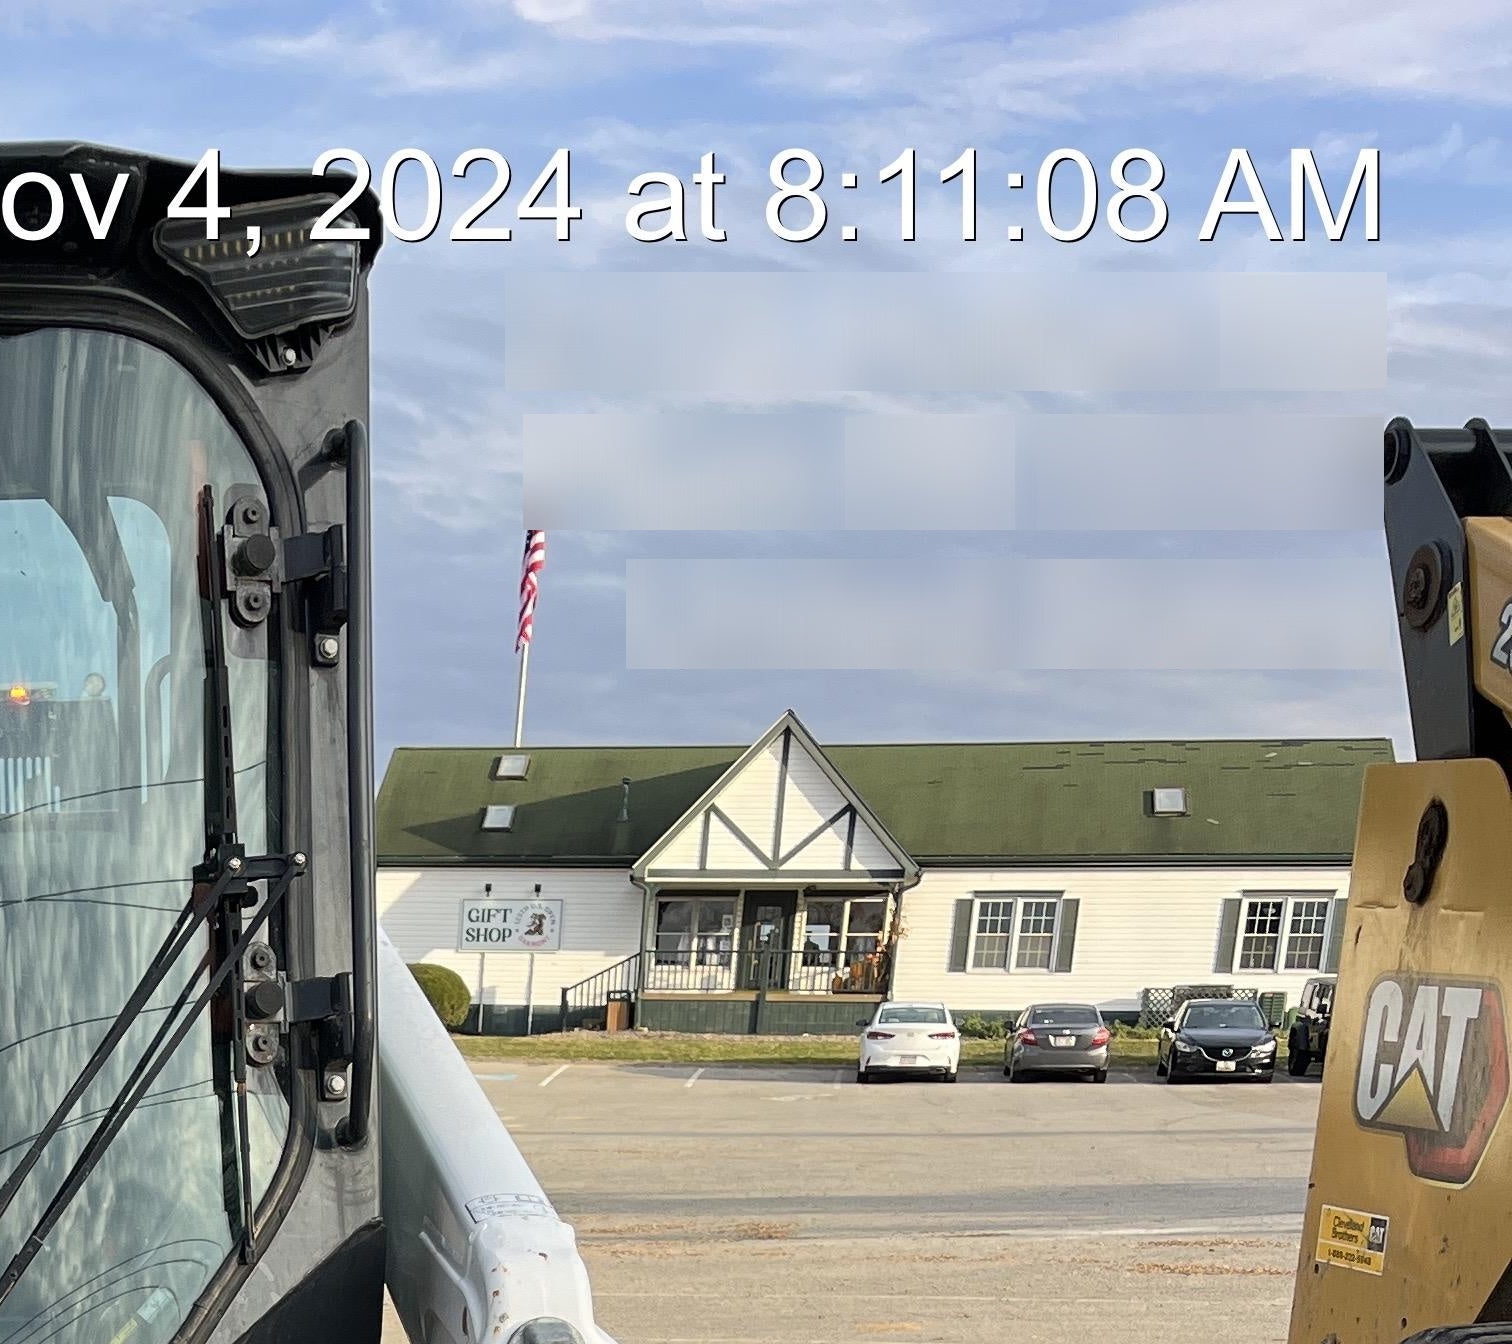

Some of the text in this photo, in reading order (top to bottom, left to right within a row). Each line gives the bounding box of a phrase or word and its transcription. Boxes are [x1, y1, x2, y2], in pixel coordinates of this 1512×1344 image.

[468, 908, 512, 923] GIFT
[465, 927, 512, 942] SHOP
[1356, 980, 1483, 1133] CAT
